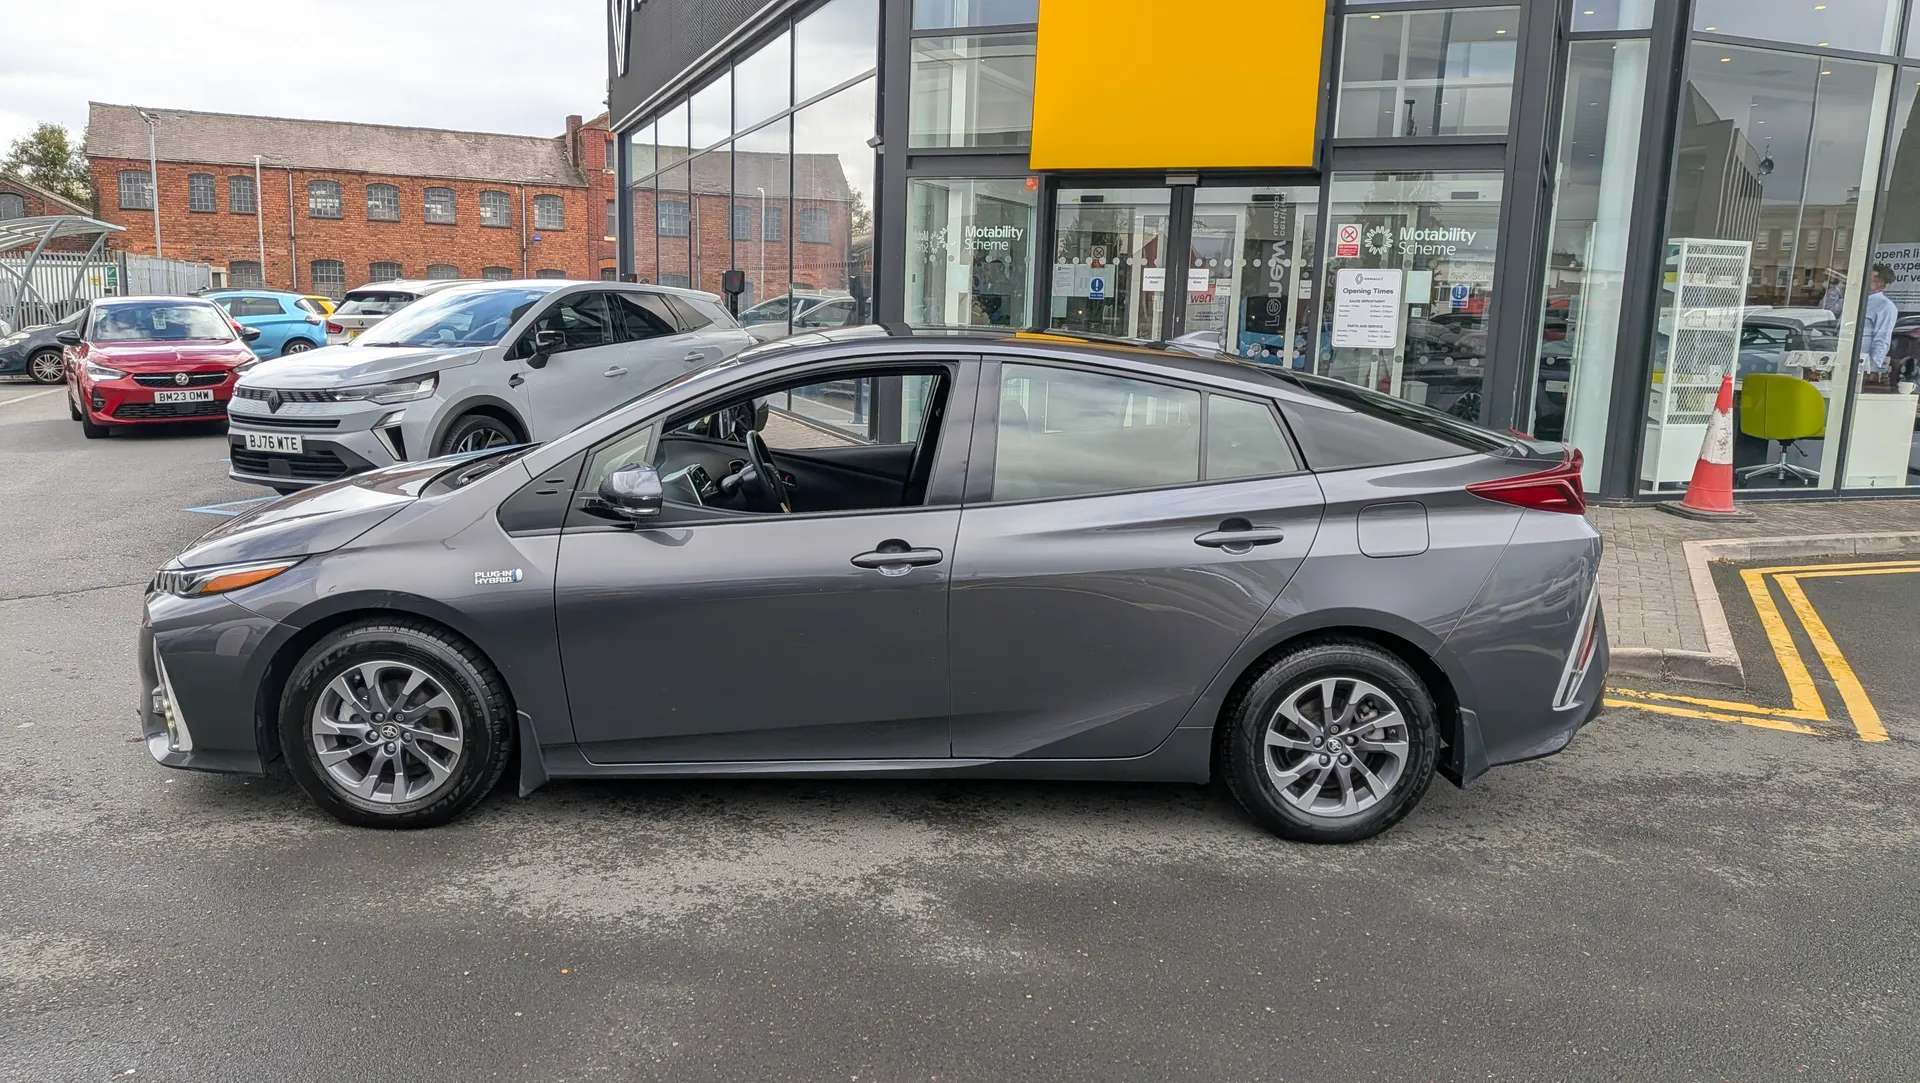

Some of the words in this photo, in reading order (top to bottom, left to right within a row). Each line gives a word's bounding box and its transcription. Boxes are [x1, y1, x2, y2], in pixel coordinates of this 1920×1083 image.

[965, 226, 1024, 241] Motability
[1399, 227, 1477, 245] Motability
[964, 238, 1009, 251] Scheme
[1398, 242, 1456, 256] Scheme
[159, 392, 187, 402] BM23
[190, 390, 210, 400] OMW
[250, 435, 275, 449] BJ76
[277, 436, 298, 450] WTE
[474, 577, 513, 585] HYBRID
